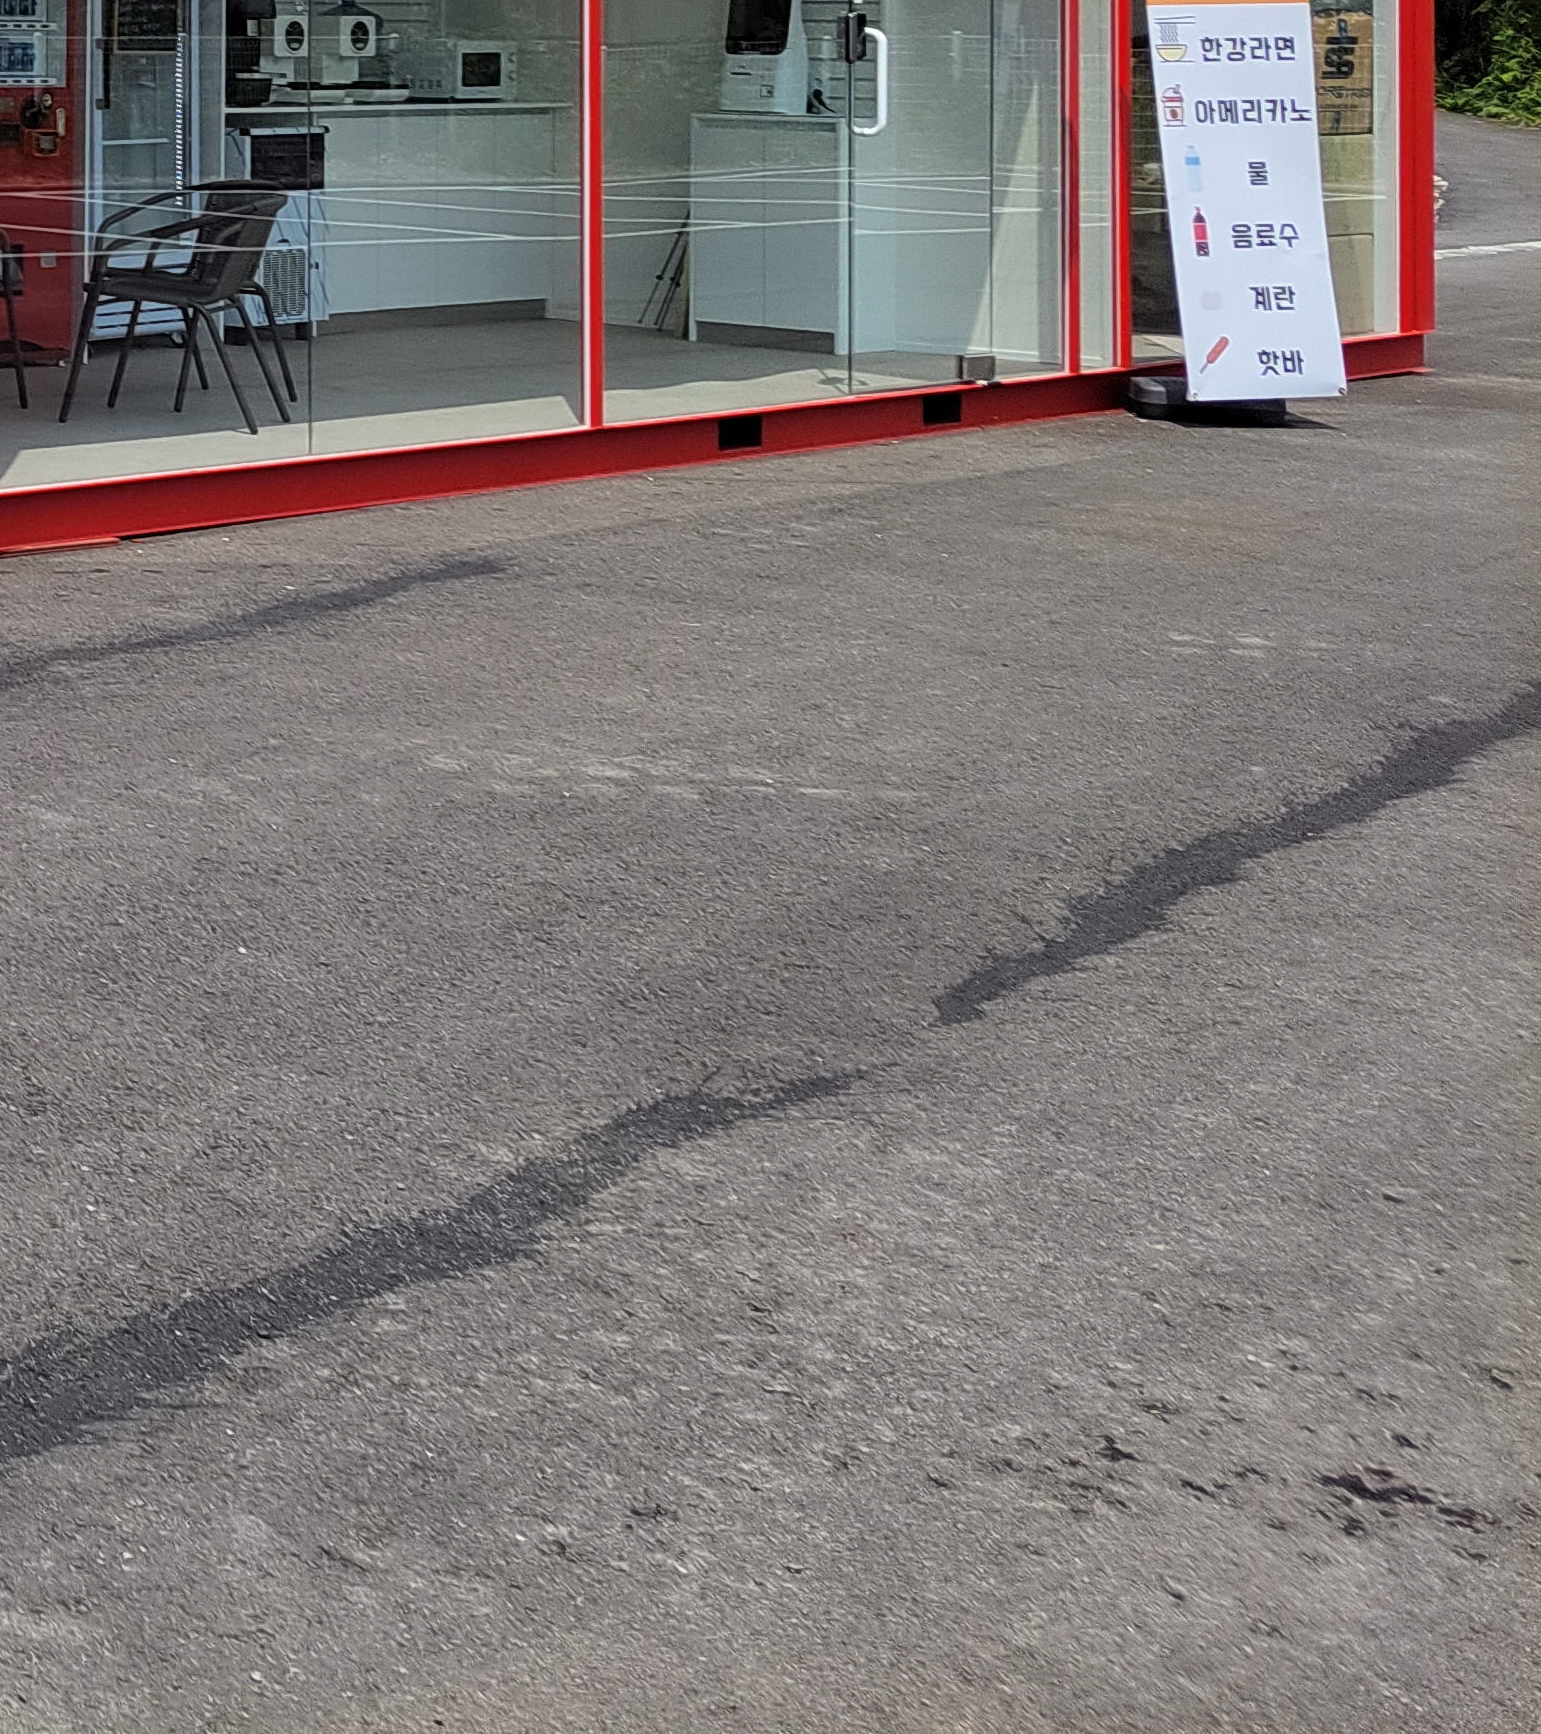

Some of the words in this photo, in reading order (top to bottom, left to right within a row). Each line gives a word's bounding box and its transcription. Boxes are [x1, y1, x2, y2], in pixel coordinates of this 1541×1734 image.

[1199, 36, 1297, 62] 한강라면
[1194, 98, 1313, 125] 아메리카노
[1247, 161, 1270, 186] 물
[1231, 223, 1300, 249] 음료수
[1248, 285, 1296, 311] 계란
[1256, 349, 1305, 376] 핫바
